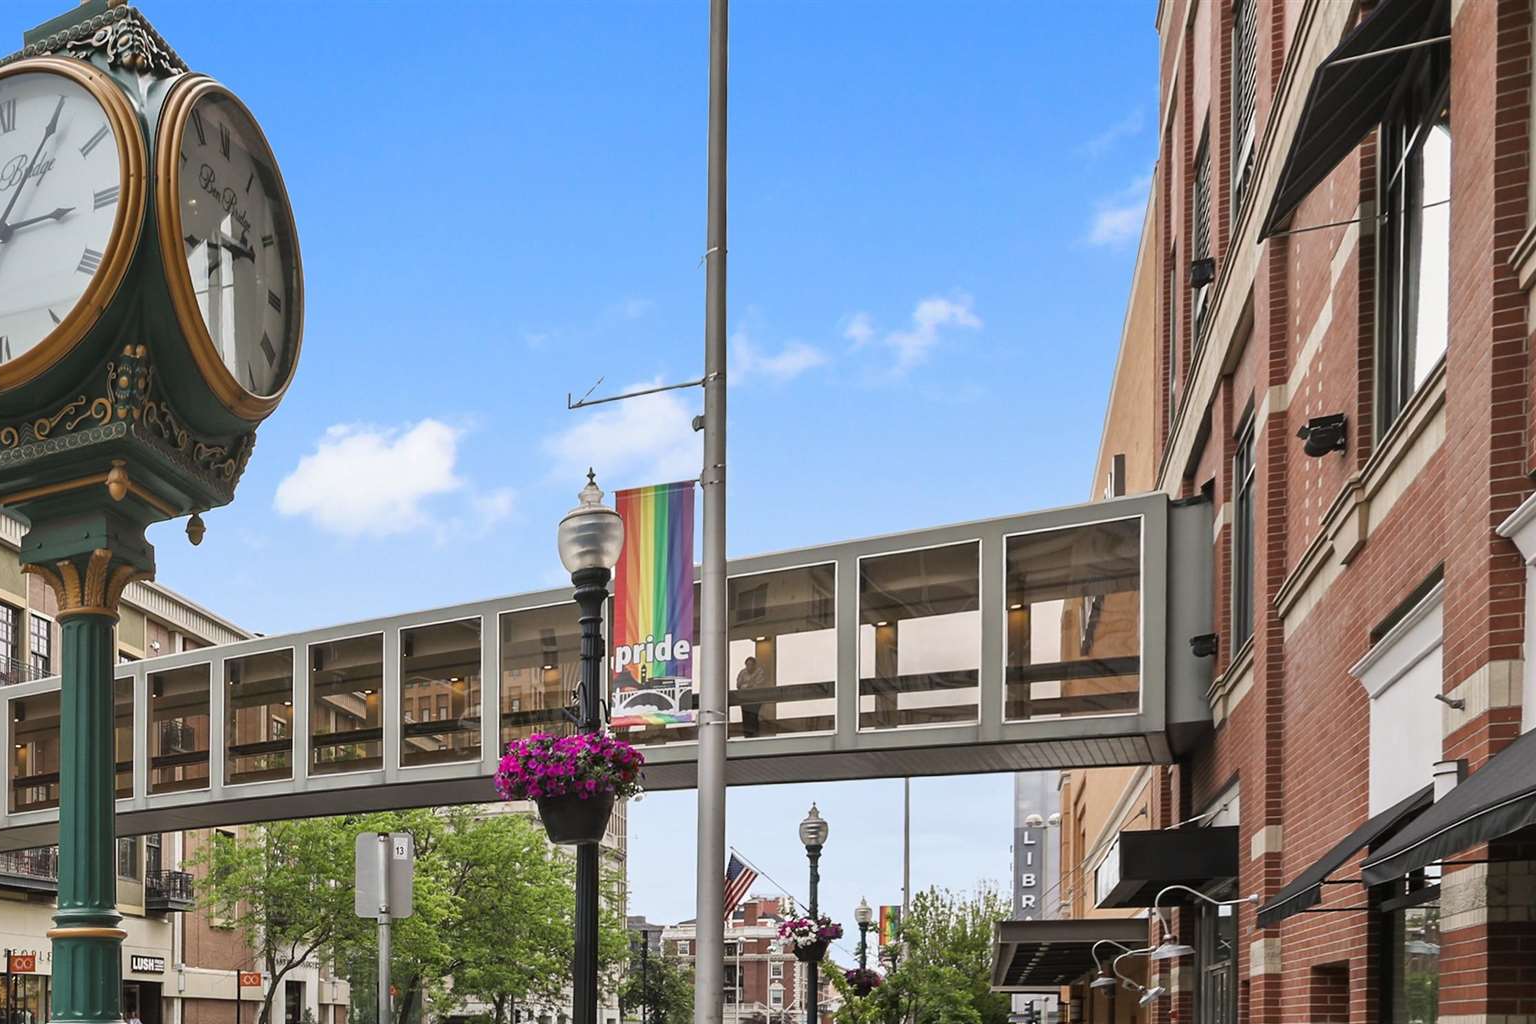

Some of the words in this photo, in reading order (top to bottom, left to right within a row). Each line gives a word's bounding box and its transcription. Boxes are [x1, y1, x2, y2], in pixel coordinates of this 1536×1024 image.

[615, 633, 691, 674] pride
[395, 846, 405, 856] 13
[132, 956, 155, 972] LUSH
